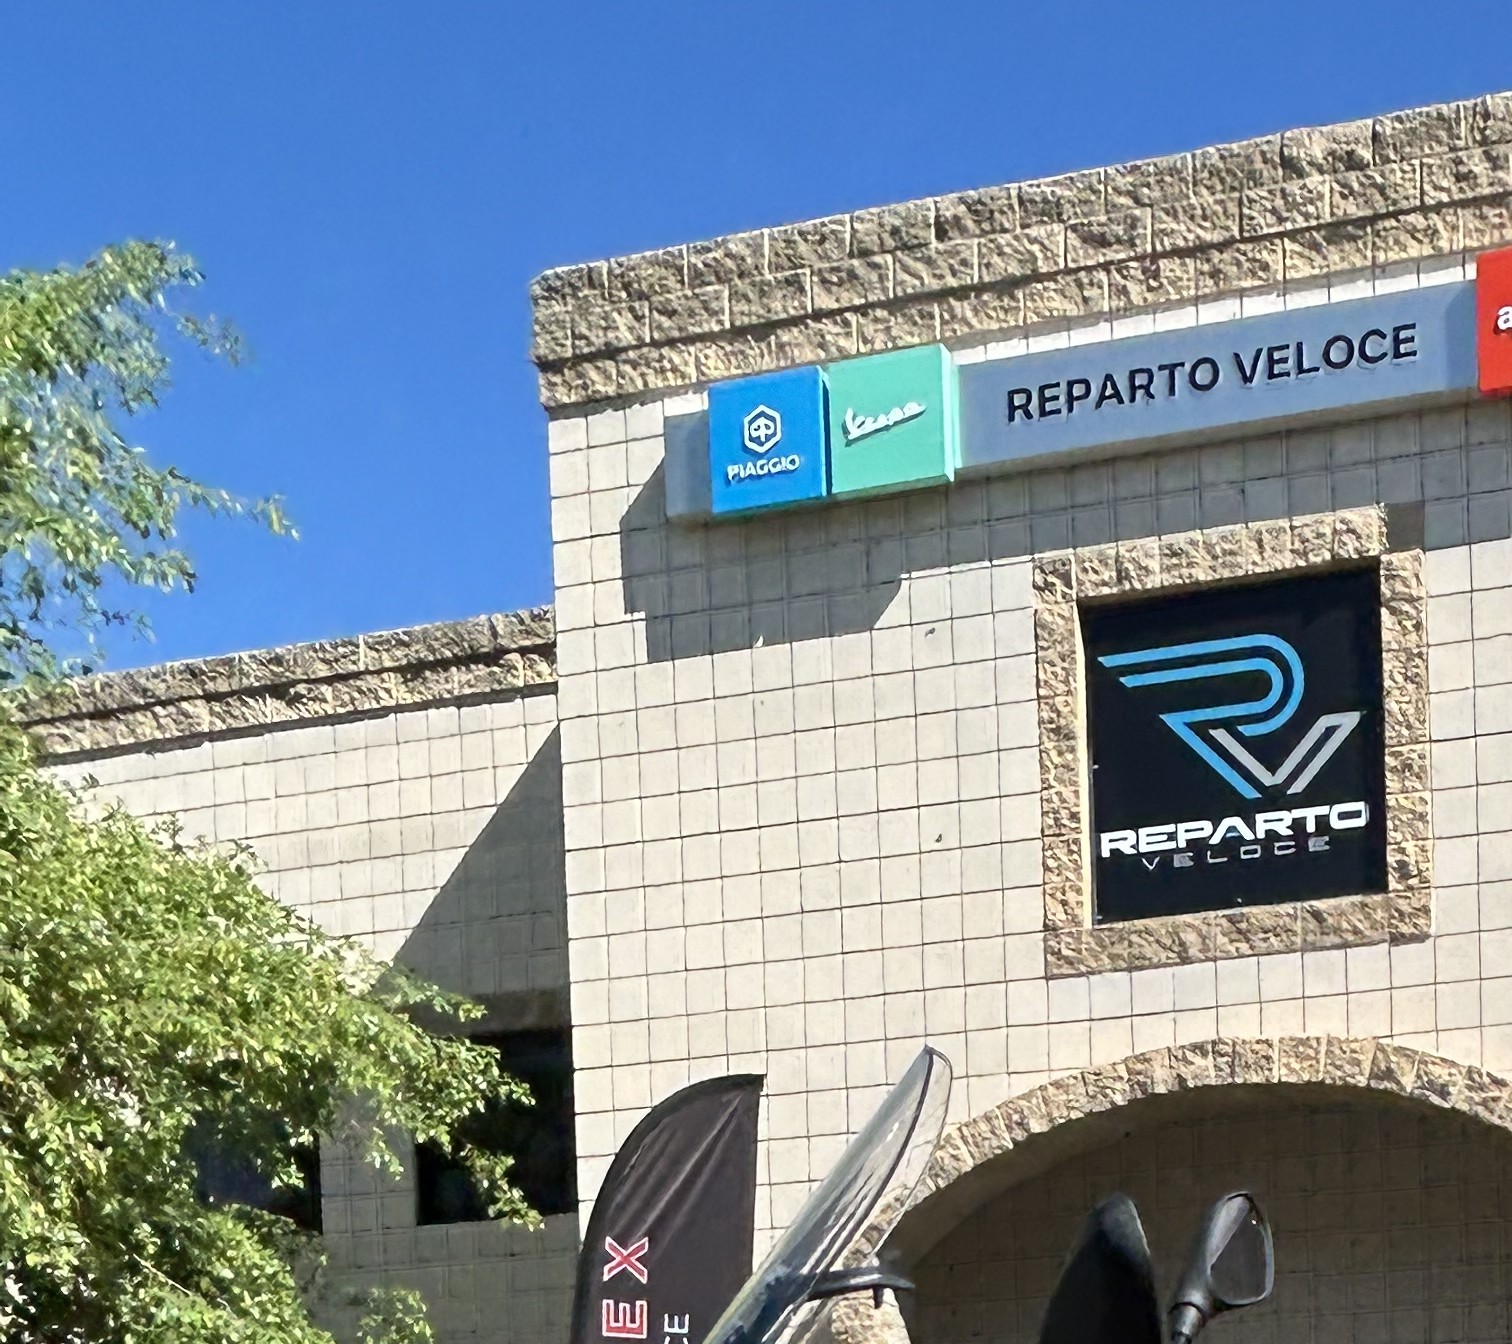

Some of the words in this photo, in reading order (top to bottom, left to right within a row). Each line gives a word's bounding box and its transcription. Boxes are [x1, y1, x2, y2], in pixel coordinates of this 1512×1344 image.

[1008, 357, 1219, 423] REPARTO
[1233, 323, 1418, 385] VELOCE
[726, 454, 801, 481] PIAGGIO
[1100, 801, 1369, 858] REPARTO
[1141, 836, 1330, 871] VELOCE
